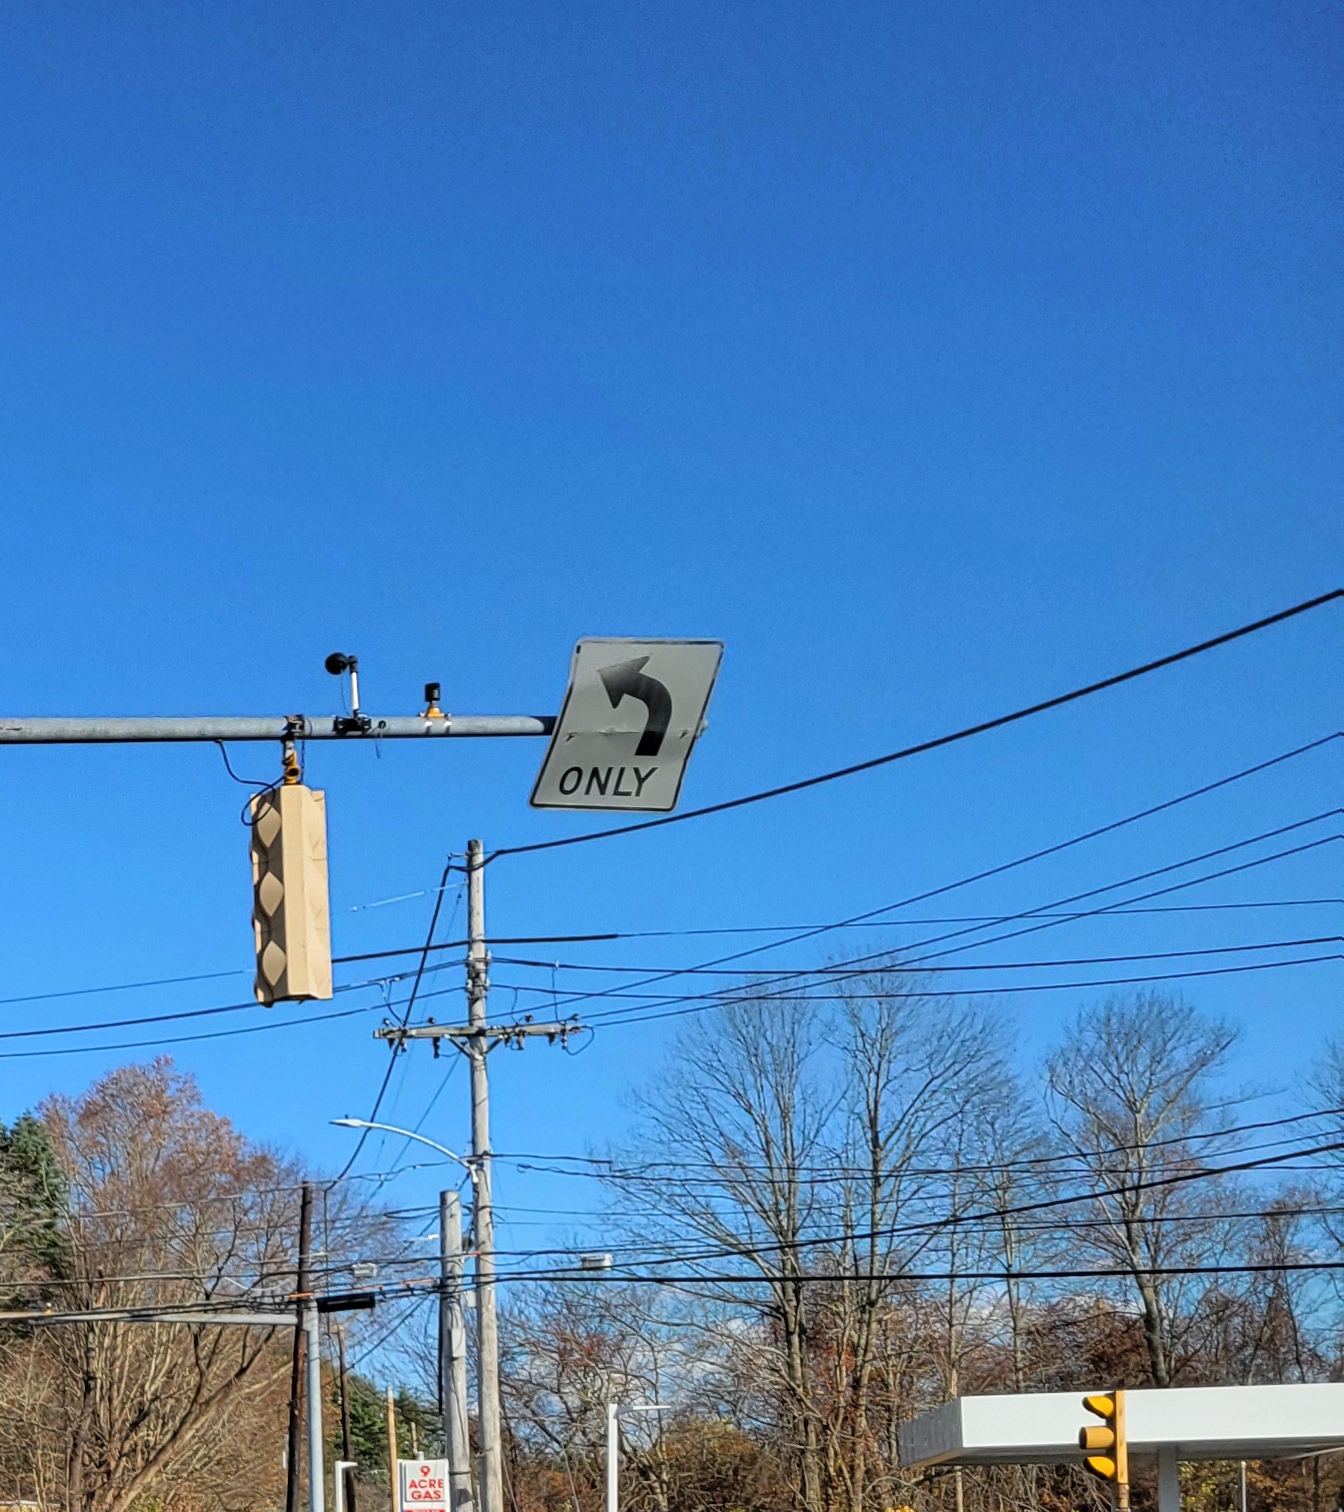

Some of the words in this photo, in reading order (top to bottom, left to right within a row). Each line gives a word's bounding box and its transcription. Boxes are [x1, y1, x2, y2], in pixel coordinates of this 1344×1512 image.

[558, 766, 659, 797] ONLY
[419, 1465, 431, 1477] 9
[409, 1479, 444, 1489] ACRE
[411, 1490, 442, 1500] GAS
